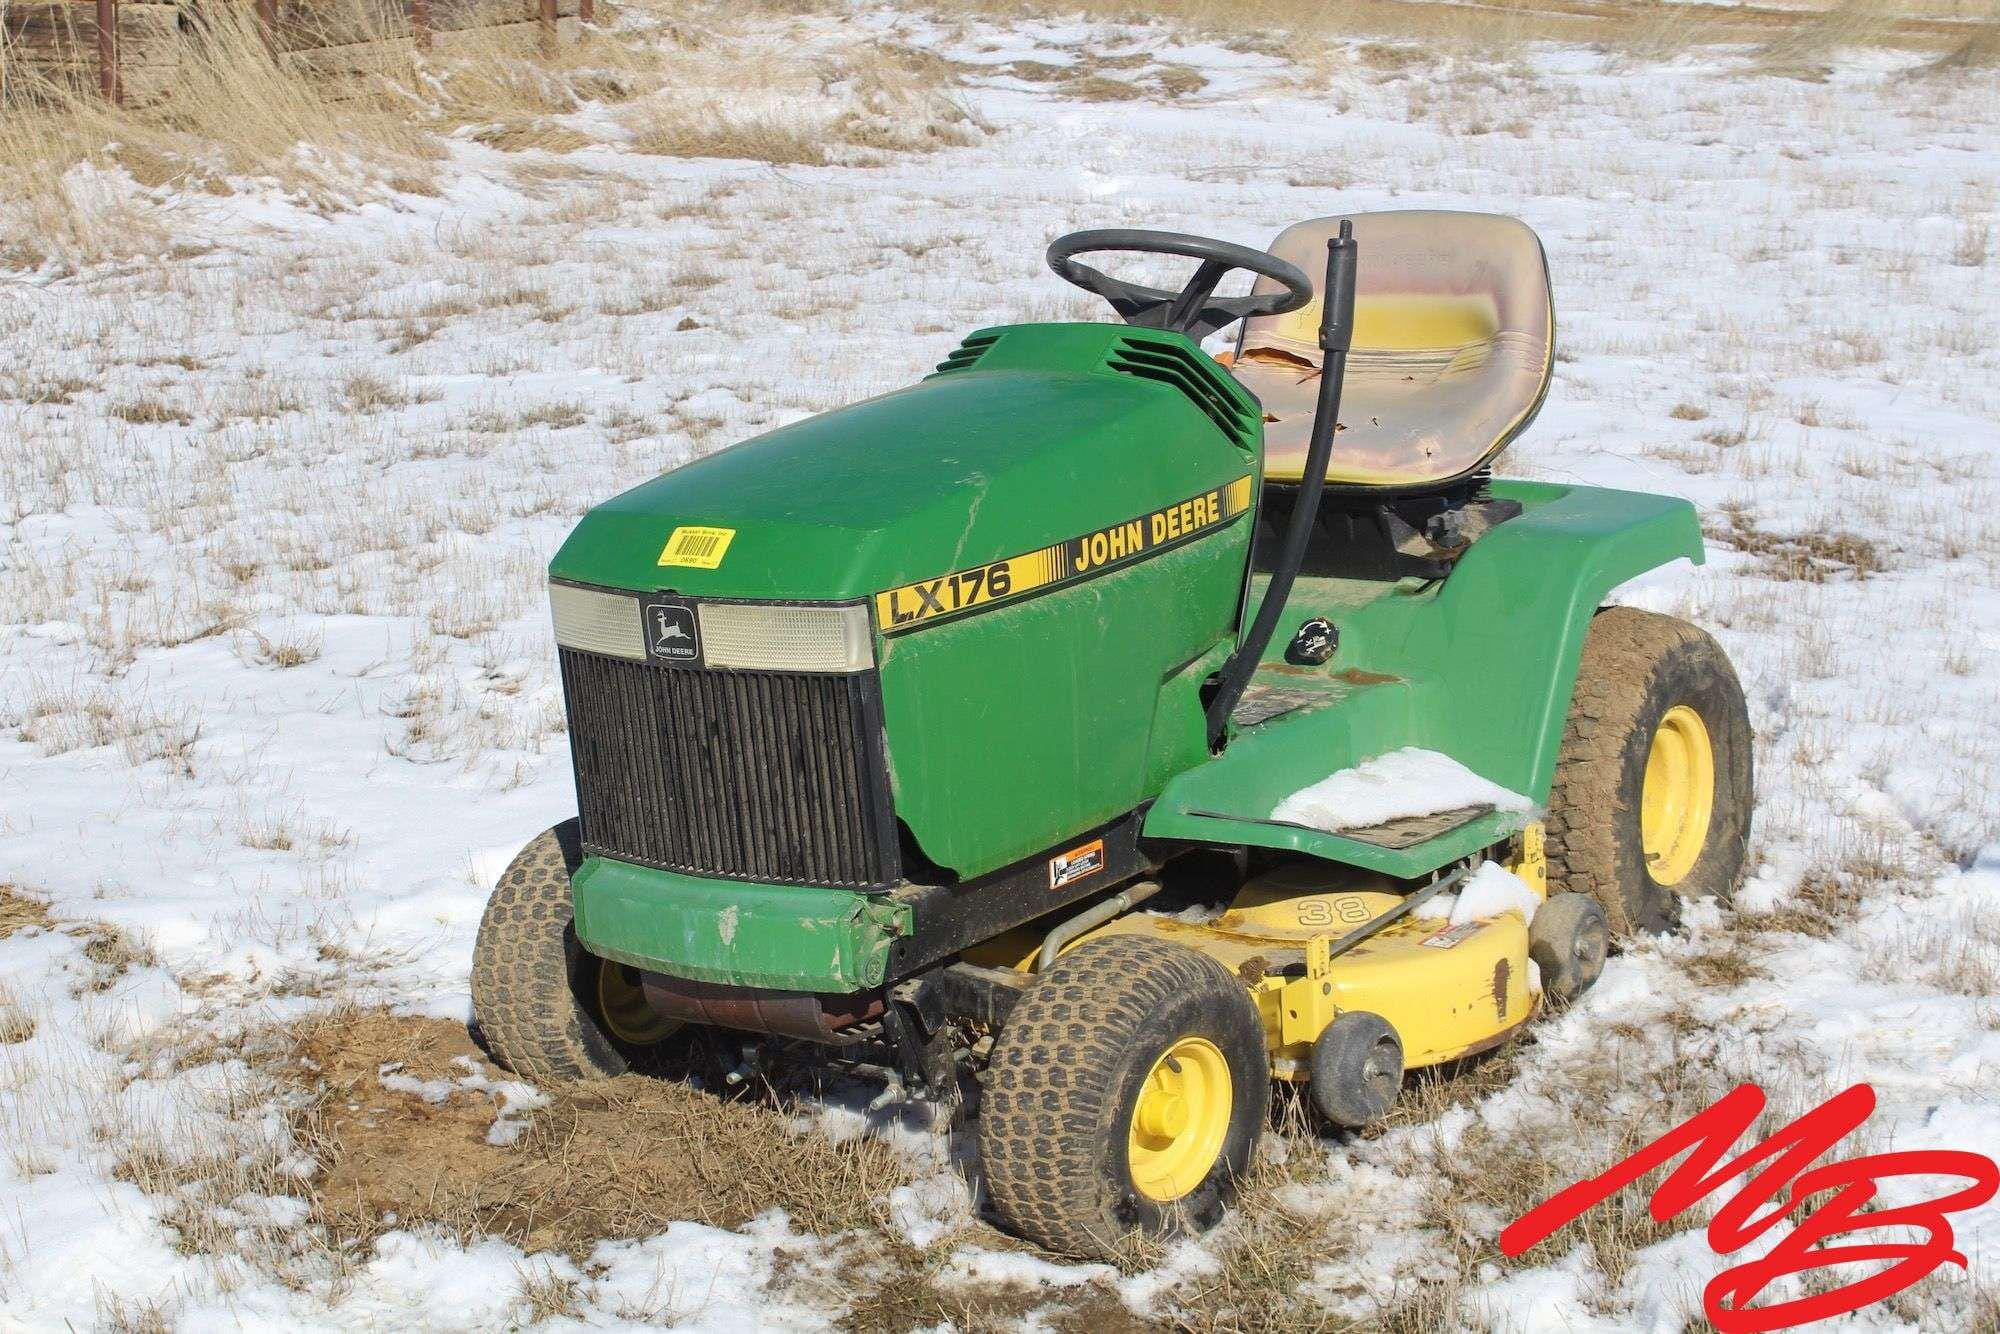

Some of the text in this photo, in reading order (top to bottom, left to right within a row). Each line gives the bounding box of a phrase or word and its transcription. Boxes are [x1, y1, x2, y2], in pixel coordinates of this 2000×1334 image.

[889, 491, 1220, 625] LX176 JOHN DEERE
[655, 645, 694, 655] JOHN DEERE
[1297, 896, 1372, 926] 38
